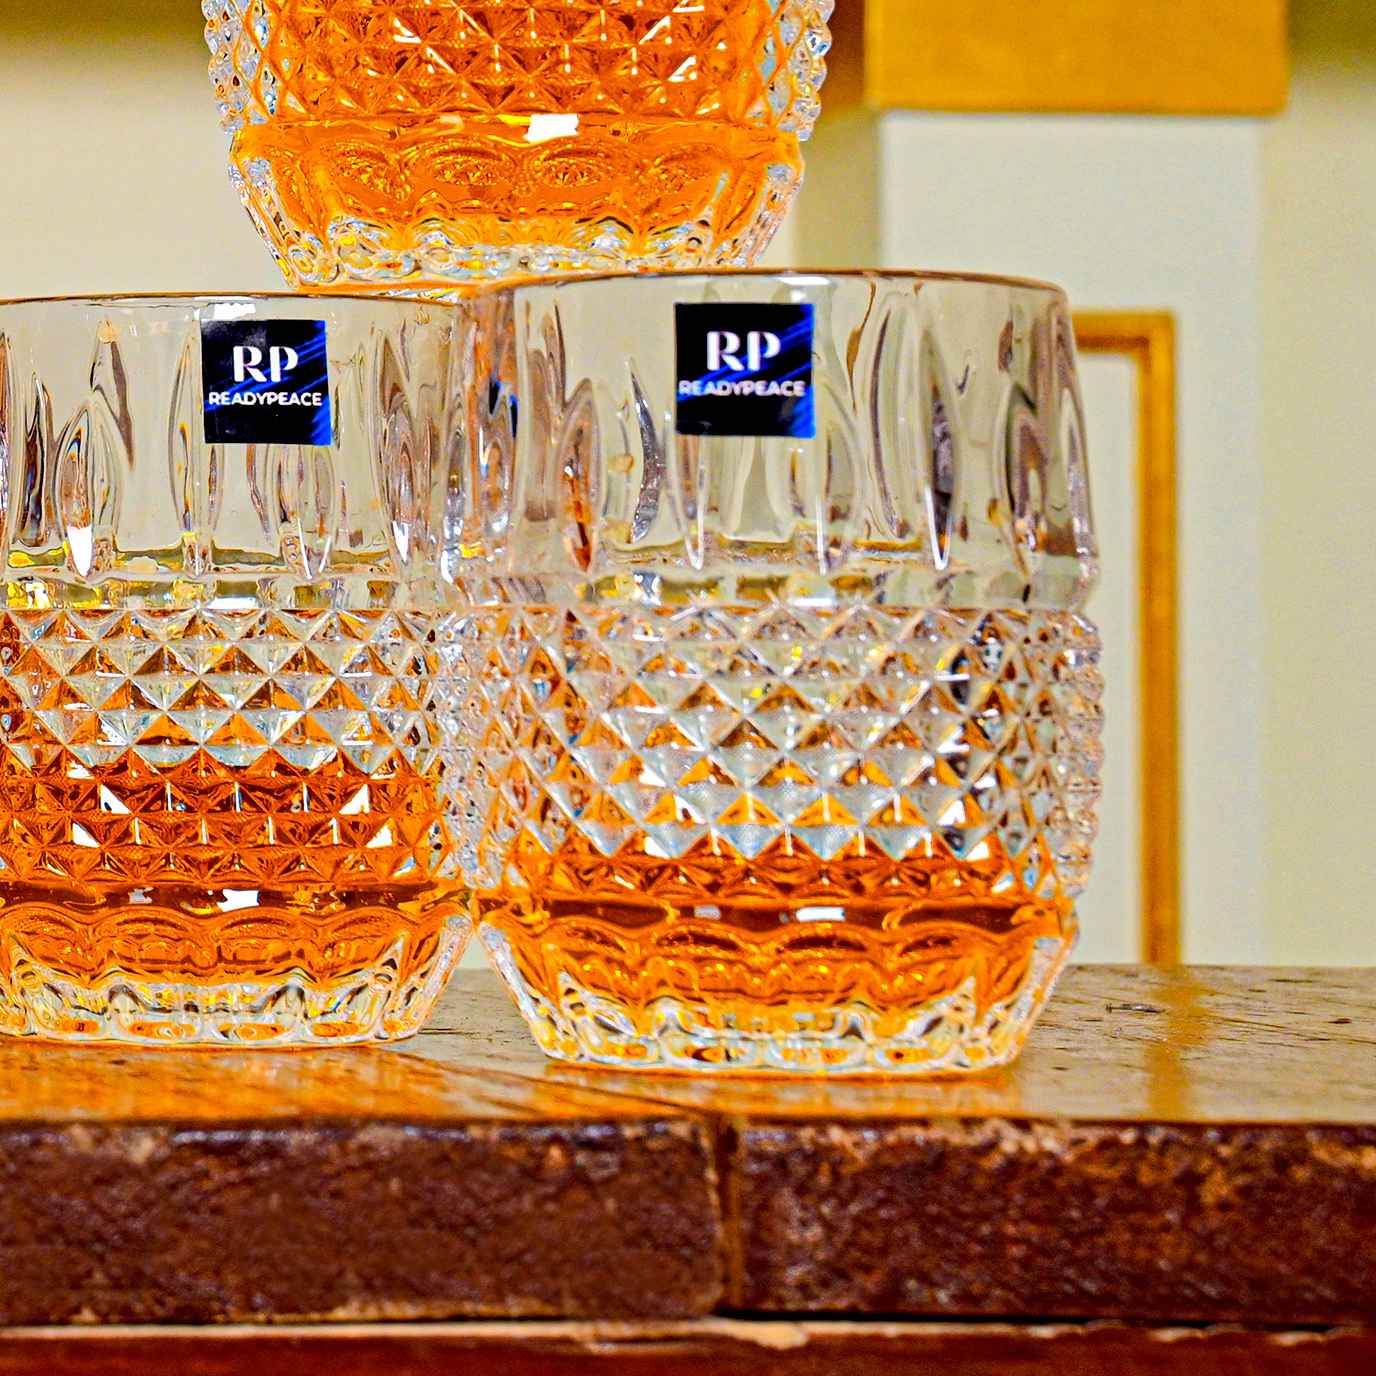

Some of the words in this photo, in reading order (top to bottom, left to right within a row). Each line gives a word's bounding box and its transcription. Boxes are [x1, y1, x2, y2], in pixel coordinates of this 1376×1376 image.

[233, 342, 298, 382] RP
[707, 331, 781, 371] RP
[209, 391, 322, 406] READYPEACE
[676, 378, 805, 397] READYPEACE
